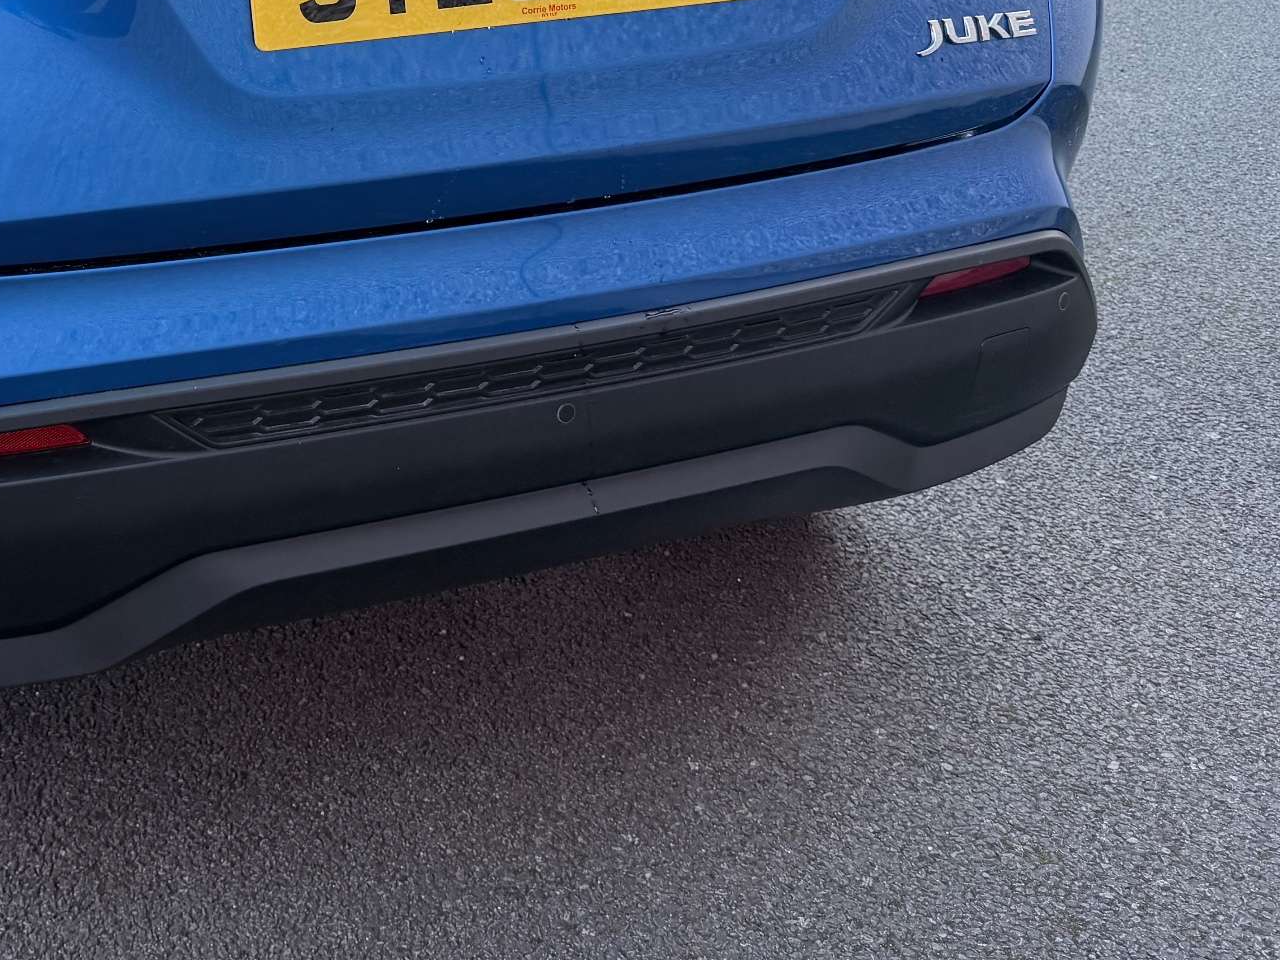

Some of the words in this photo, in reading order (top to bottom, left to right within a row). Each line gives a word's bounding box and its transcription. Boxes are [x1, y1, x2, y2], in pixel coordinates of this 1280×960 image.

[521, 6, 547, 15] Corrie
[548, 3, 577, 13] Motors
[916, 10, 1038, 57] JUKE
